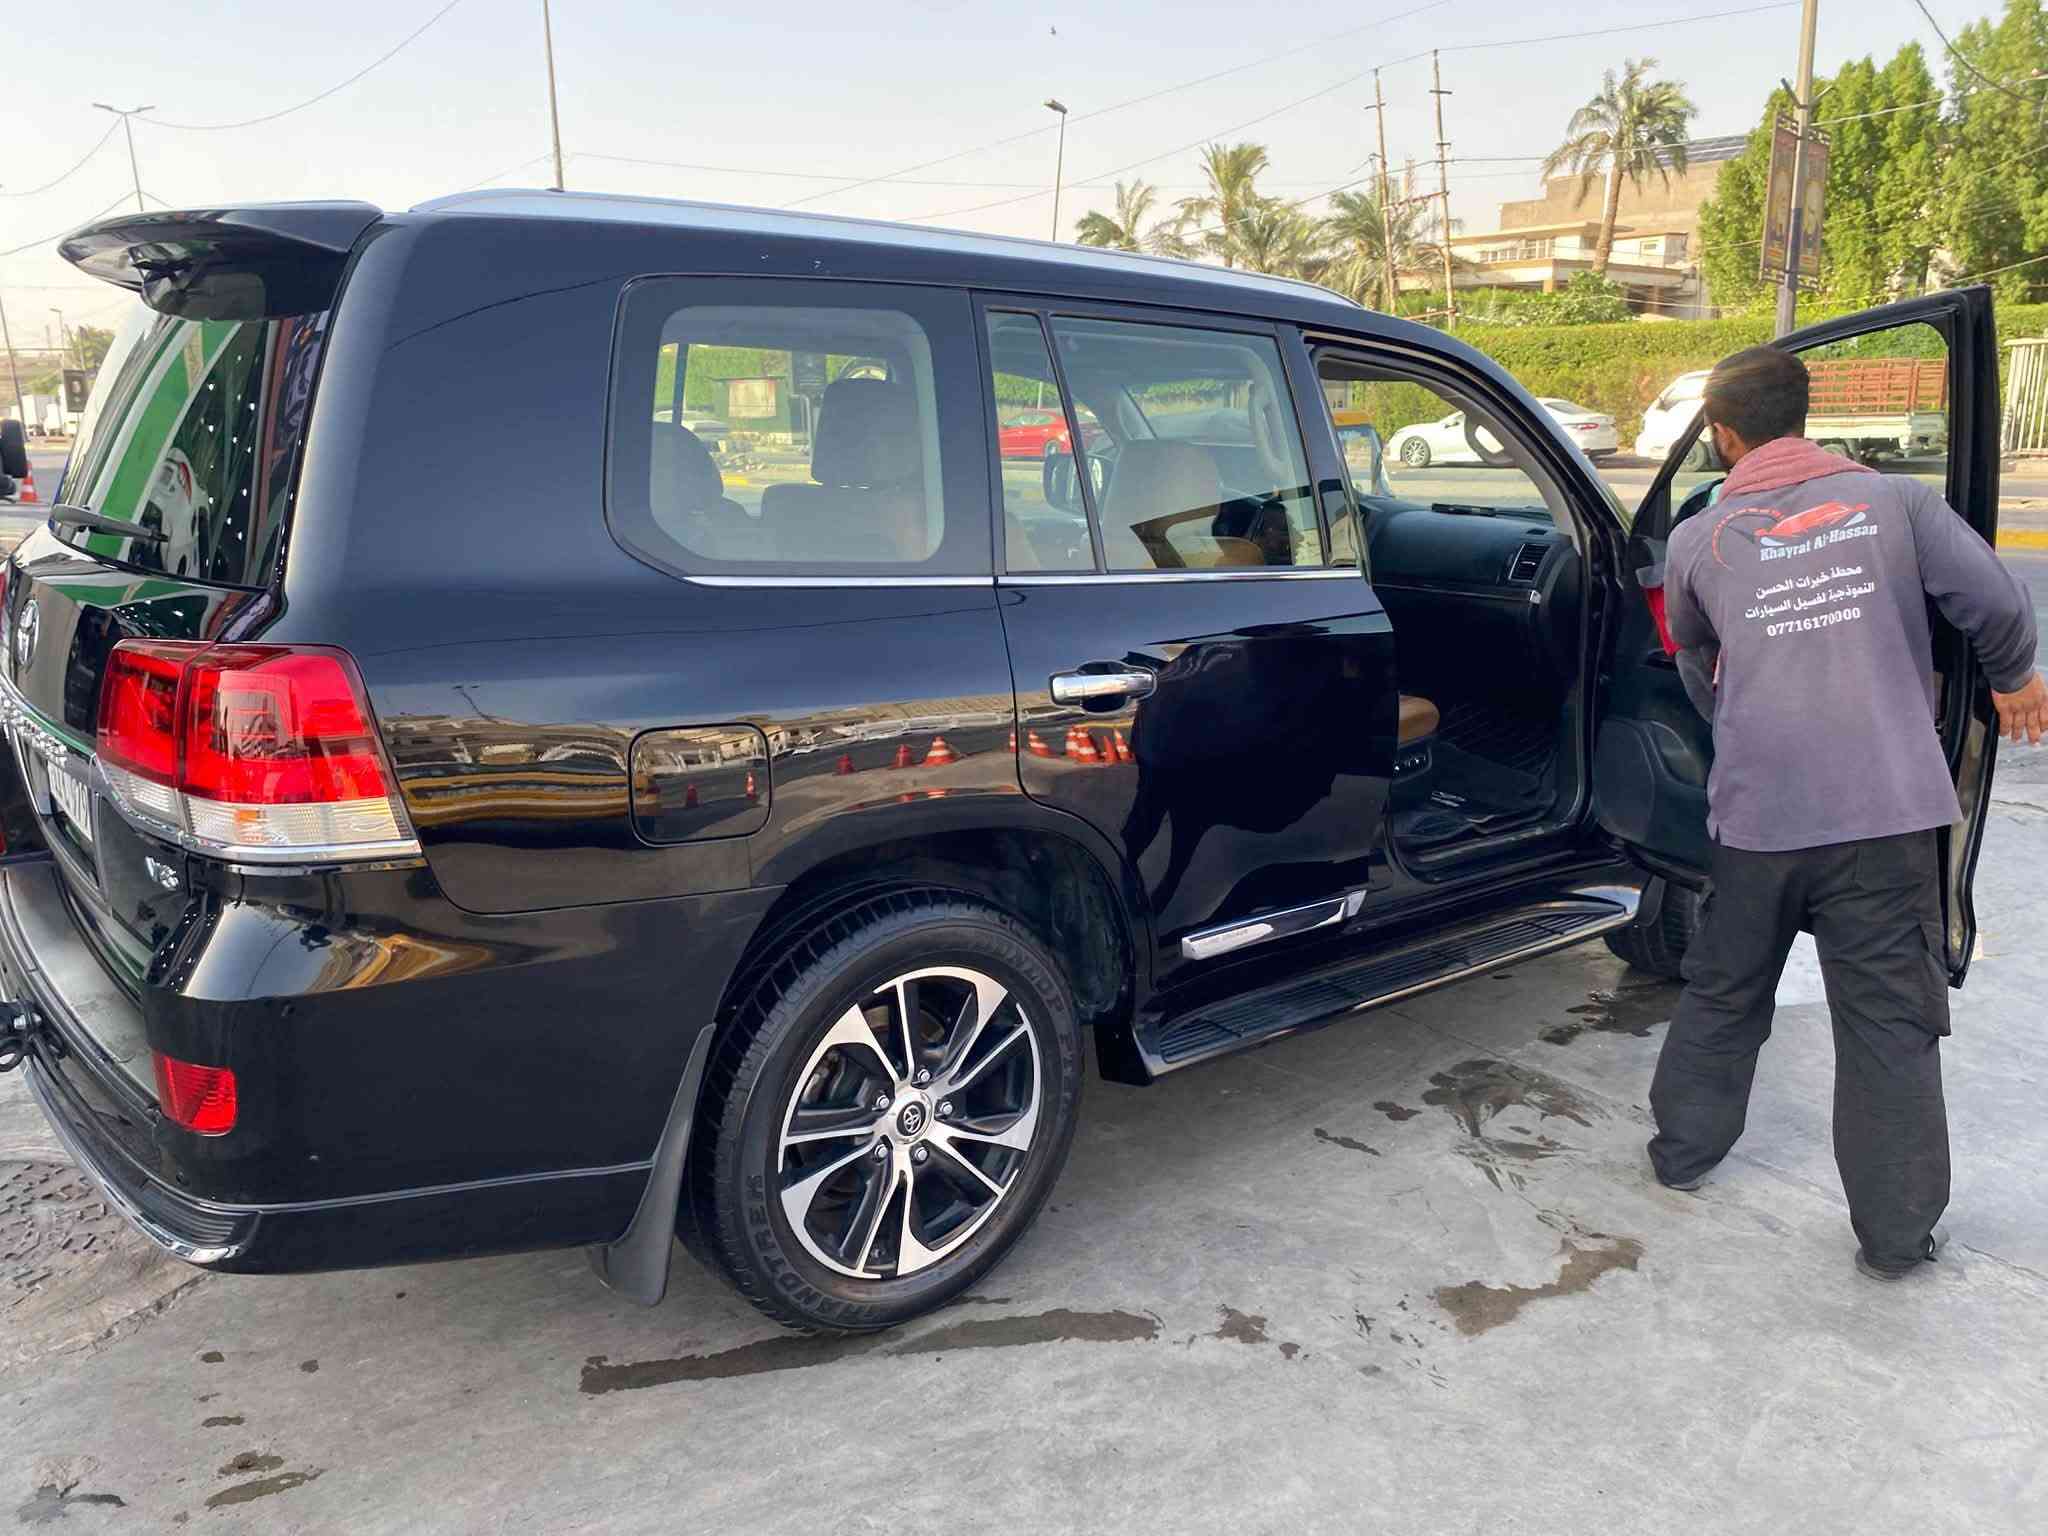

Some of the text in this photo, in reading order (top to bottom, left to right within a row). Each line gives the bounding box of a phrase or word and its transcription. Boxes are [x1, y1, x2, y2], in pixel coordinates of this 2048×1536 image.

[1760, 541, 1811, 561] Khayrat
[1755, 565, 1863, 600] محطة خيرات الحسن
[1828, 581, 1875, 602] النموذجية
[1744, 599, 1792, 619] السيارات
